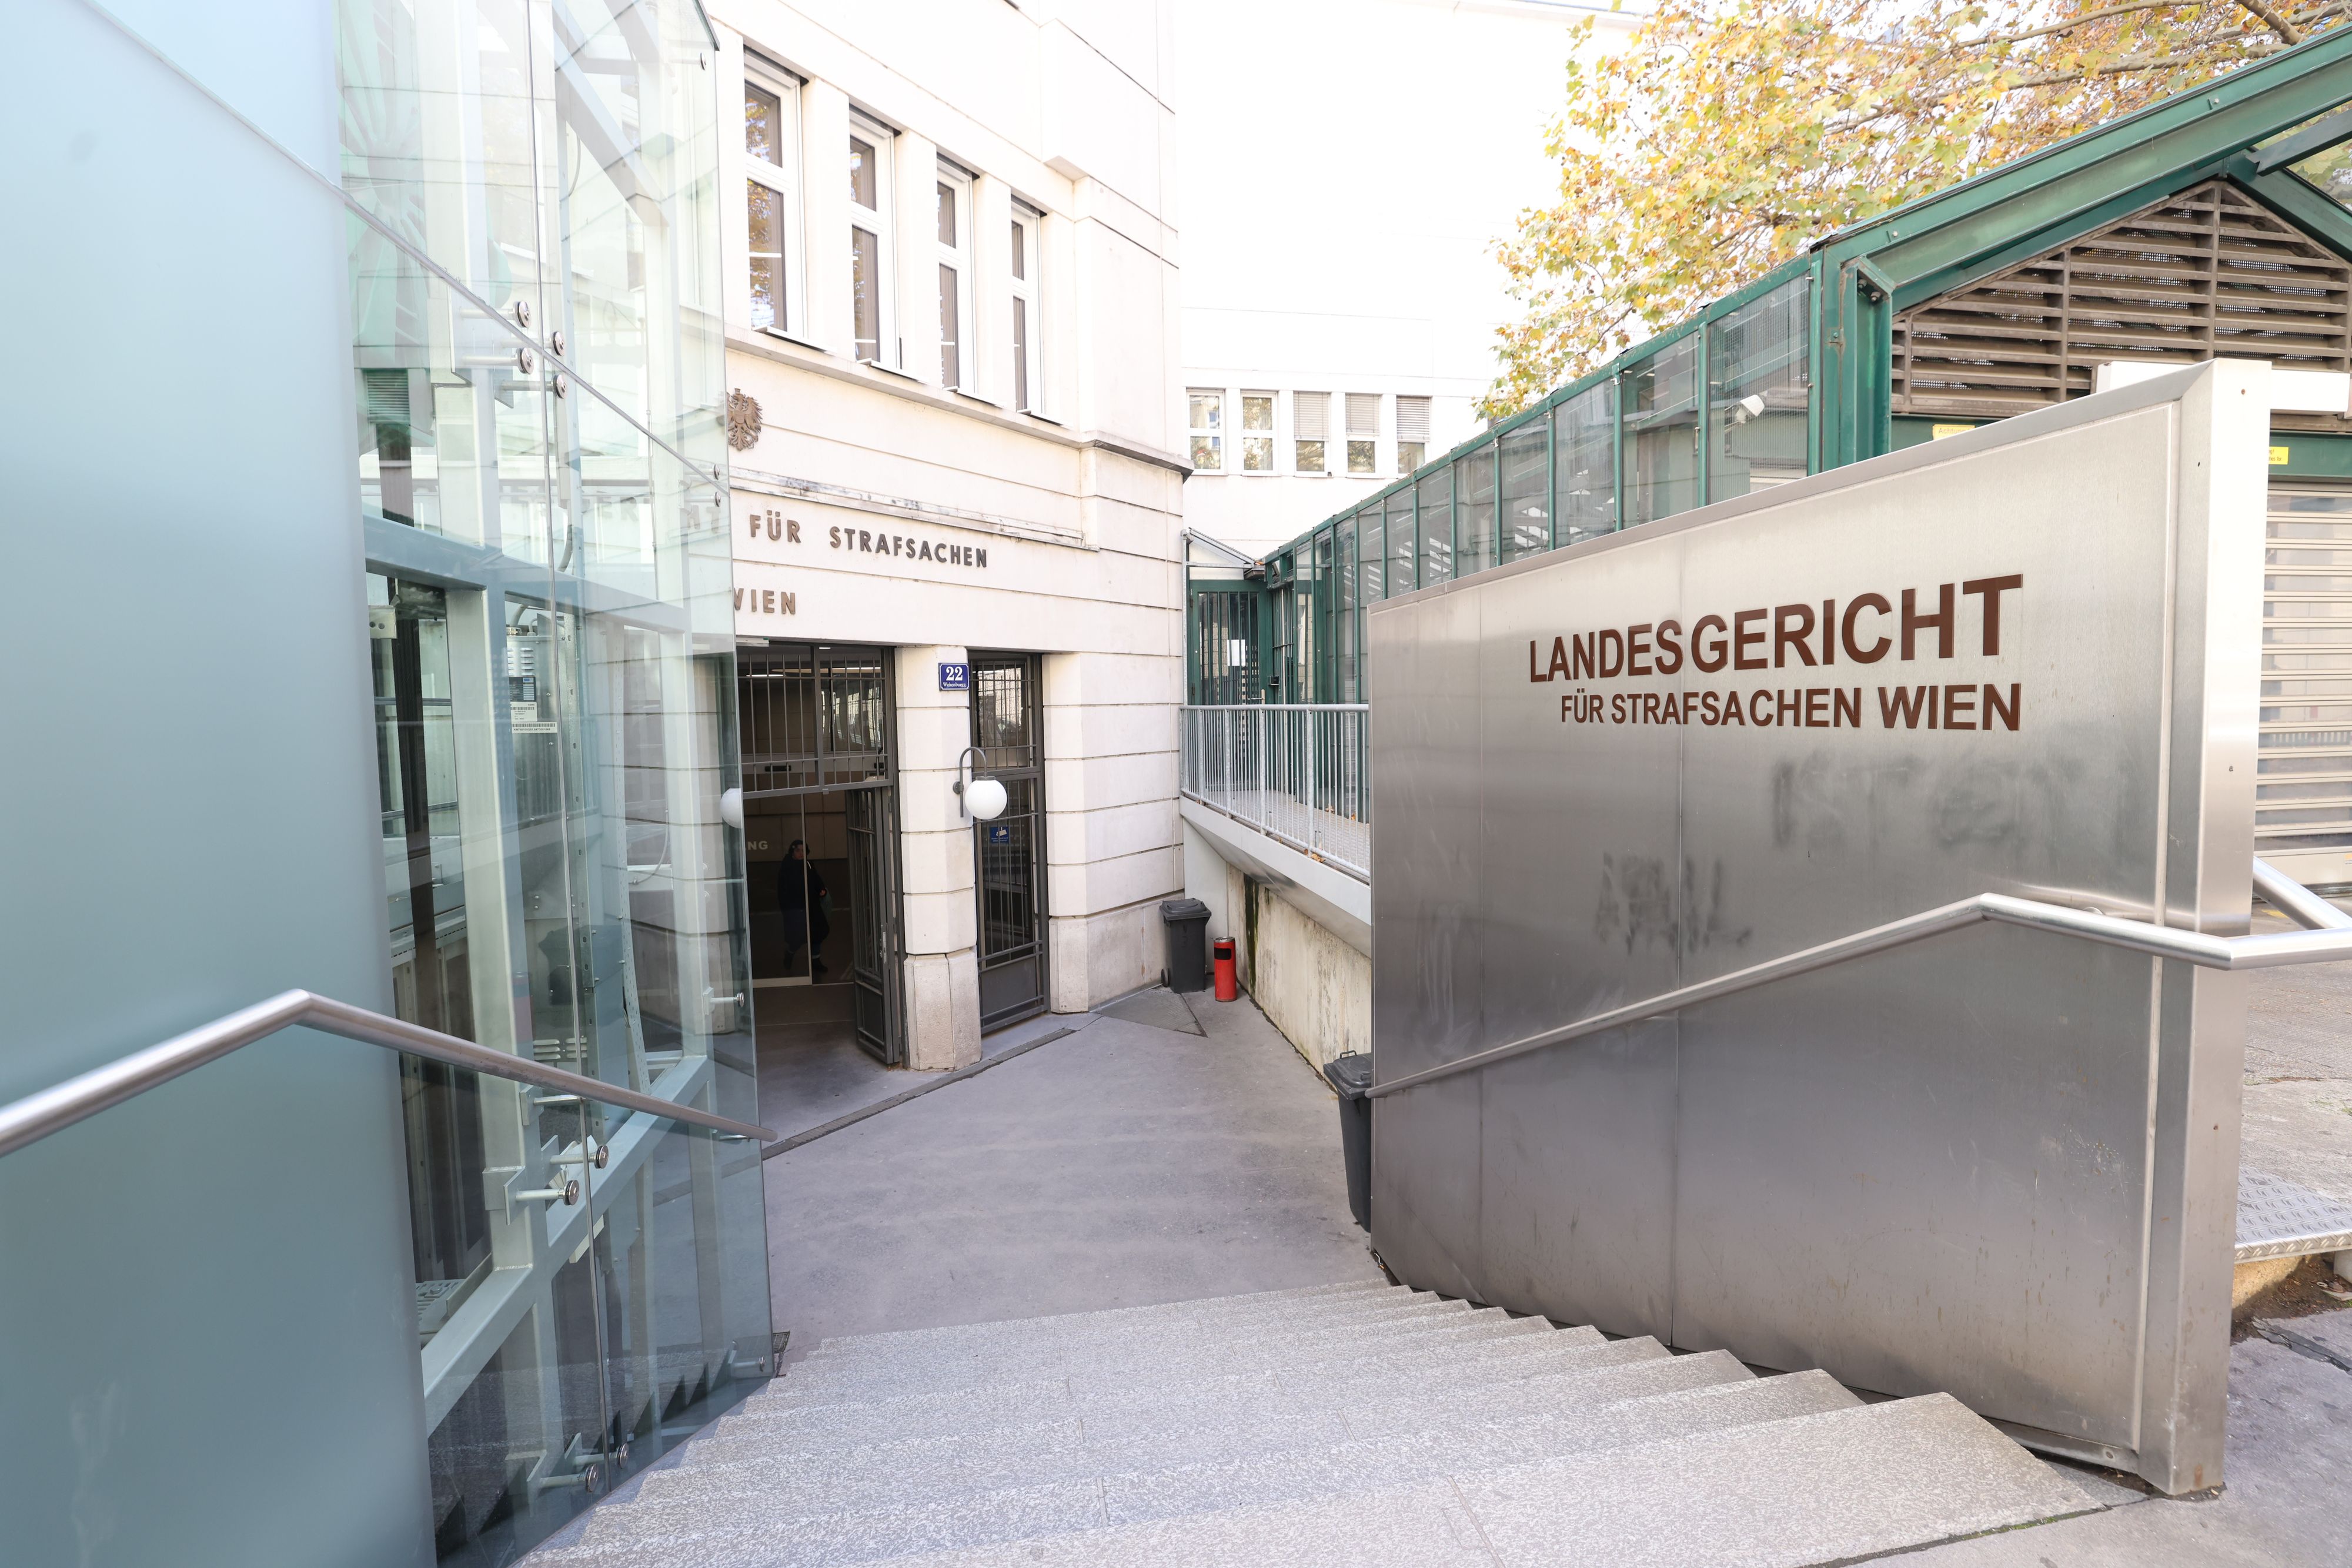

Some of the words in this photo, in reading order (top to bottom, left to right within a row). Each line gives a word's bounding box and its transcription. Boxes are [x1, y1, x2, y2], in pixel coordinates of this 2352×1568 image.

[750, 510, 801, 543] FÜR
[829, 526, 987, 568] STRAFSACHEN
[1530, 574, 2023, 683] LANDESGERICHT
[946, 666, 963, 681] 22
[1561, 688, 1605, 724] FÜR
[1611, 687, 1862, 728] STRAFSACHEN
[1877, 683, 2022, 731] WIEN
